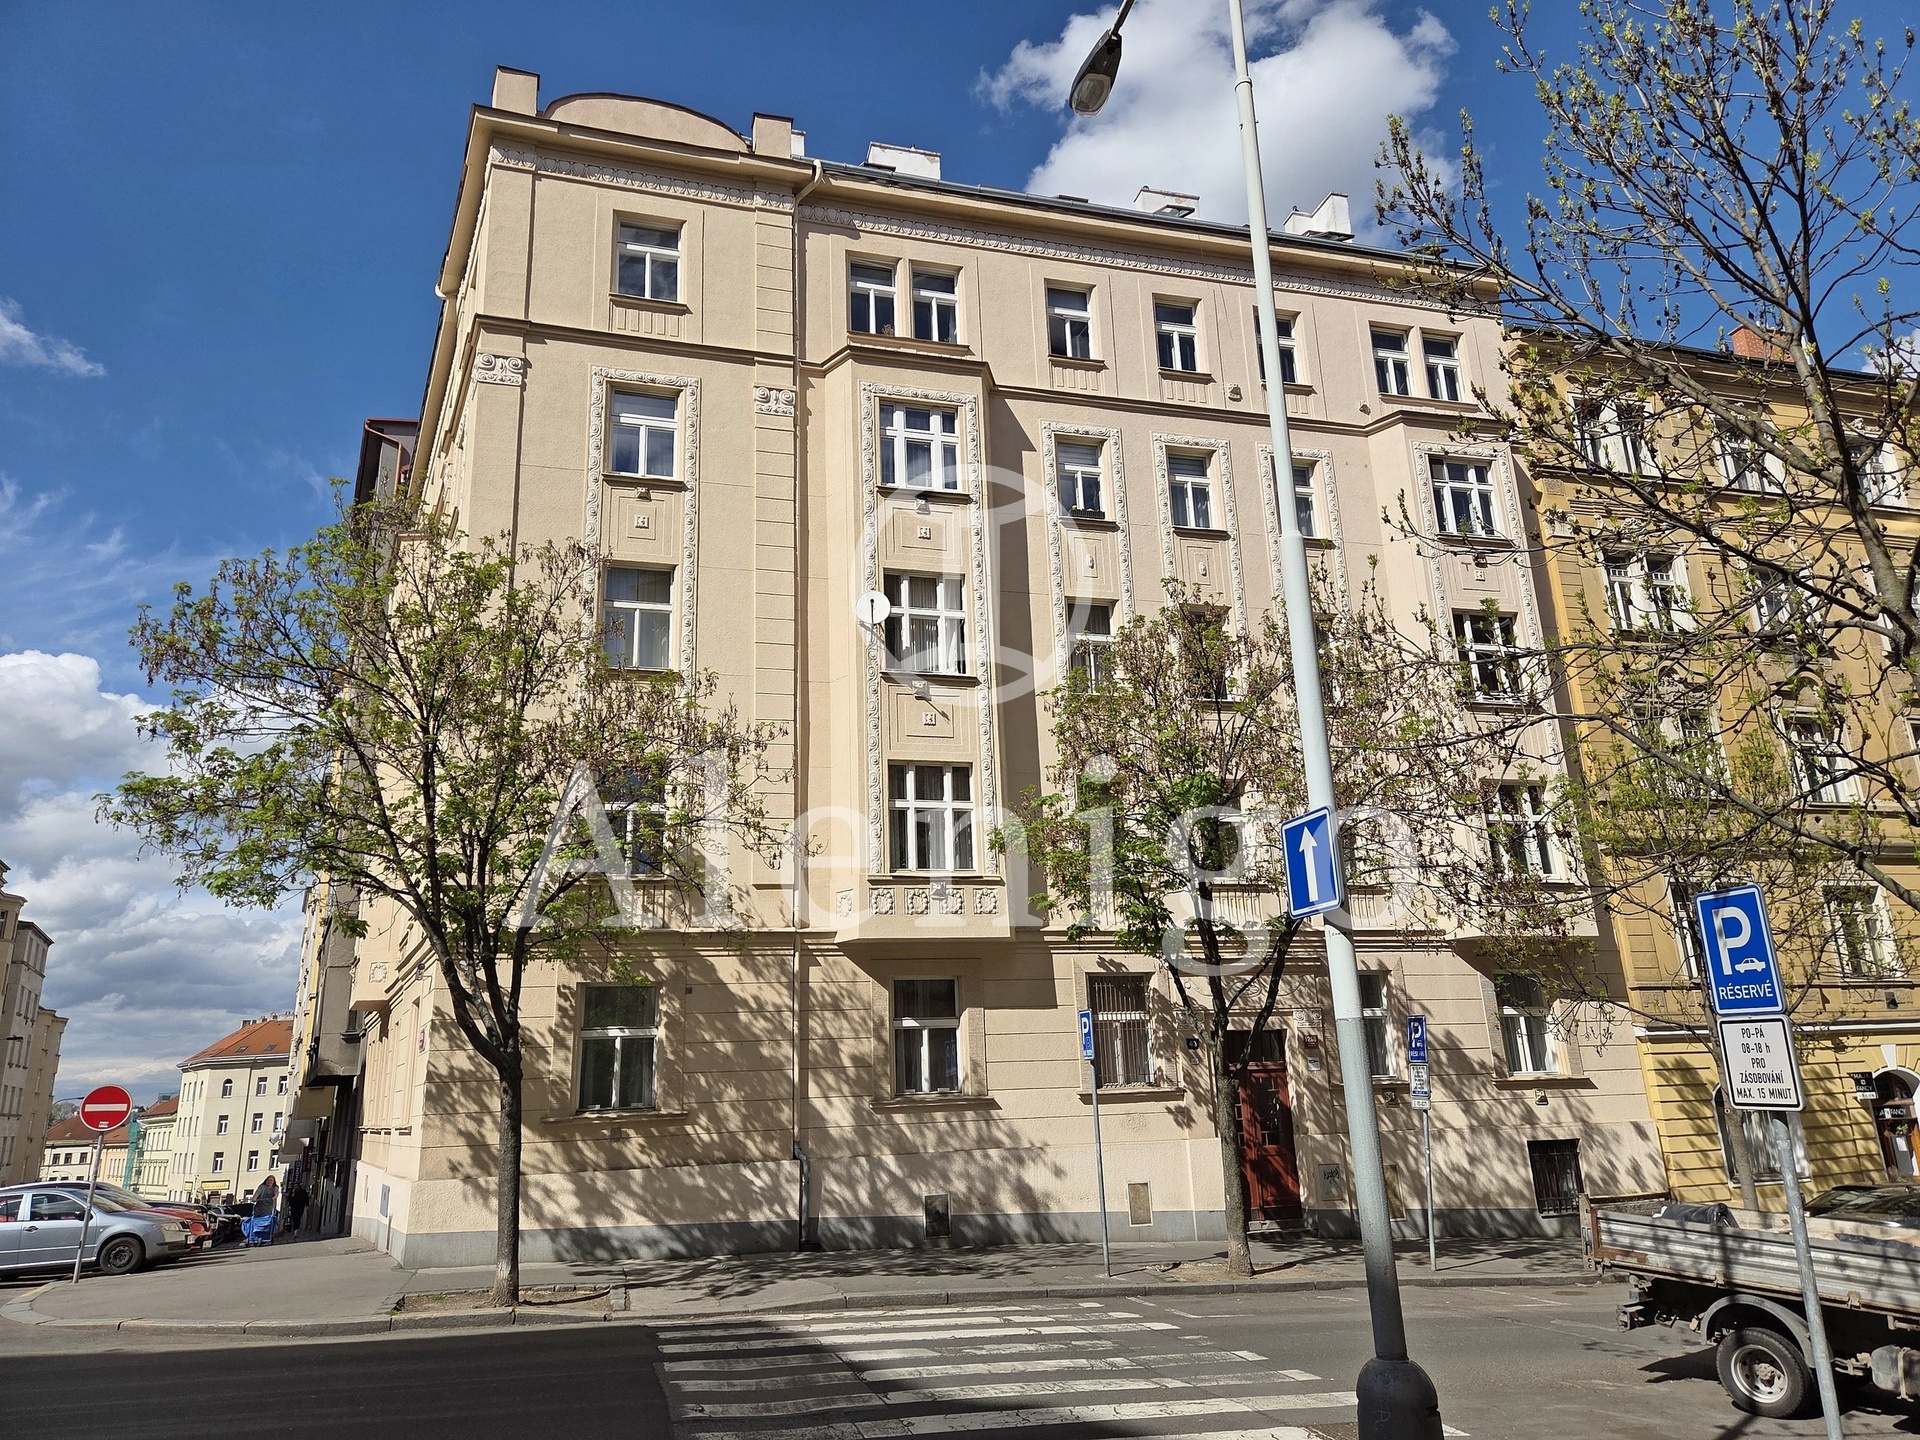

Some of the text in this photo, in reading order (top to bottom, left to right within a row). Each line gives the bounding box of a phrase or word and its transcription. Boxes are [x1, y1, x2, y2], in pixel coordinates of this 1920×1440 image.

[1711, 906, 1752, 976] P
[1718, 980, 1774, 1000] RÉSERVÉ
[1741, 1025, 1765, 1039] PO-PÁ
[1741, 1042, 1771, 1054] 08-18 h
[1751, 1058, 1766, 1069] PRO
[1739, 1070, 1784, 1084] ZÁSOBOVÁNÍ
[1736, 1087, 1792, 1100] MAX. 15 MINUT
[1890, 1108, 1907, 1116] FANCY
